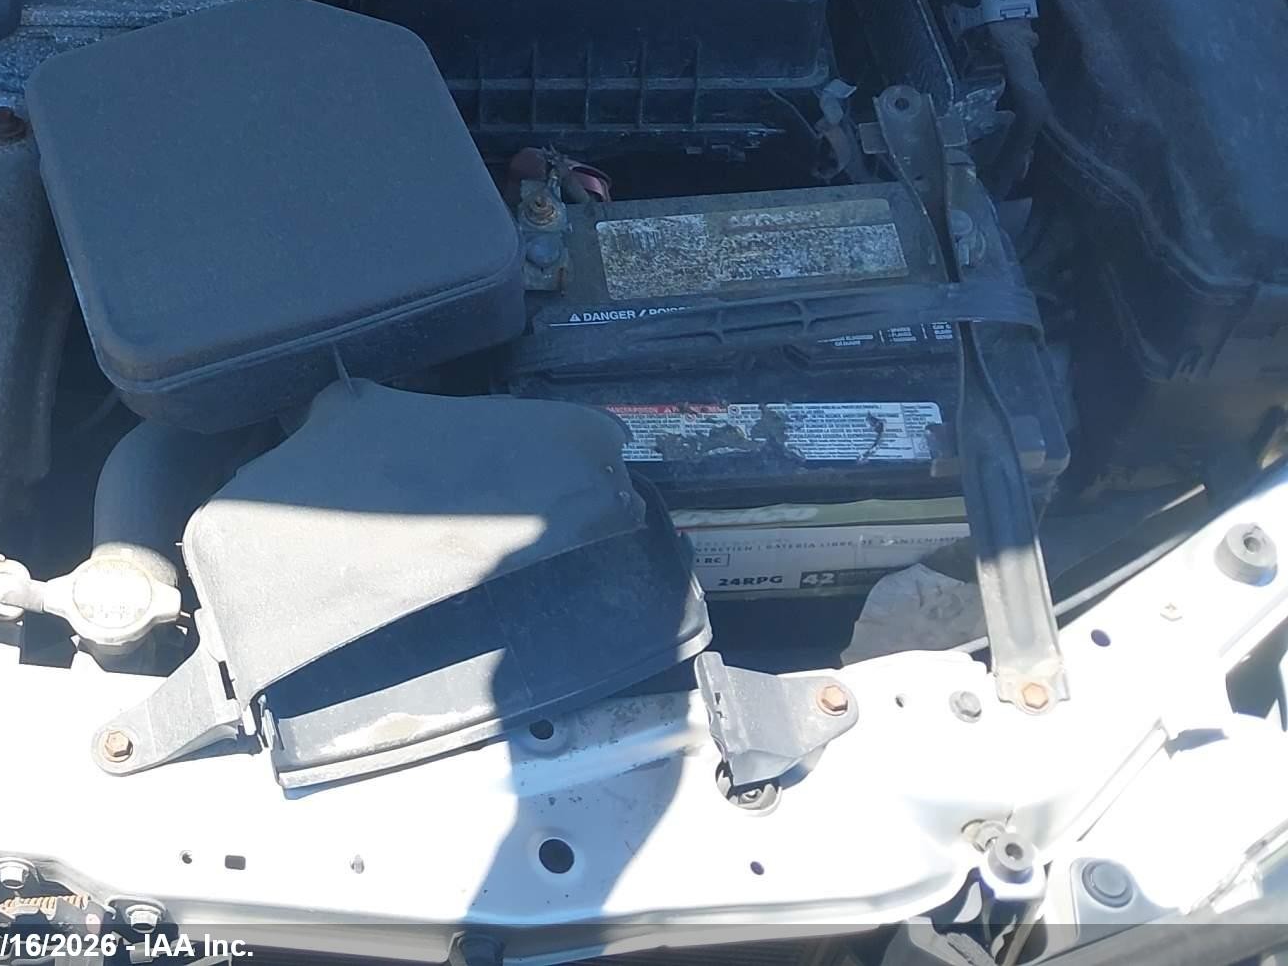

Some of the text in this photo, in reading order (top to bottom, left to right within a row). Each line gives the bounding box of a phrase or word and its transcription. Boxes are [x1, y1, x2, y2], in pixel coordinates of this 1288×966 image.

[583, 310, 636, 323] DANGER
[718, 575, 784, 587] 24RPG
[802, 572, 835, 585] 42
